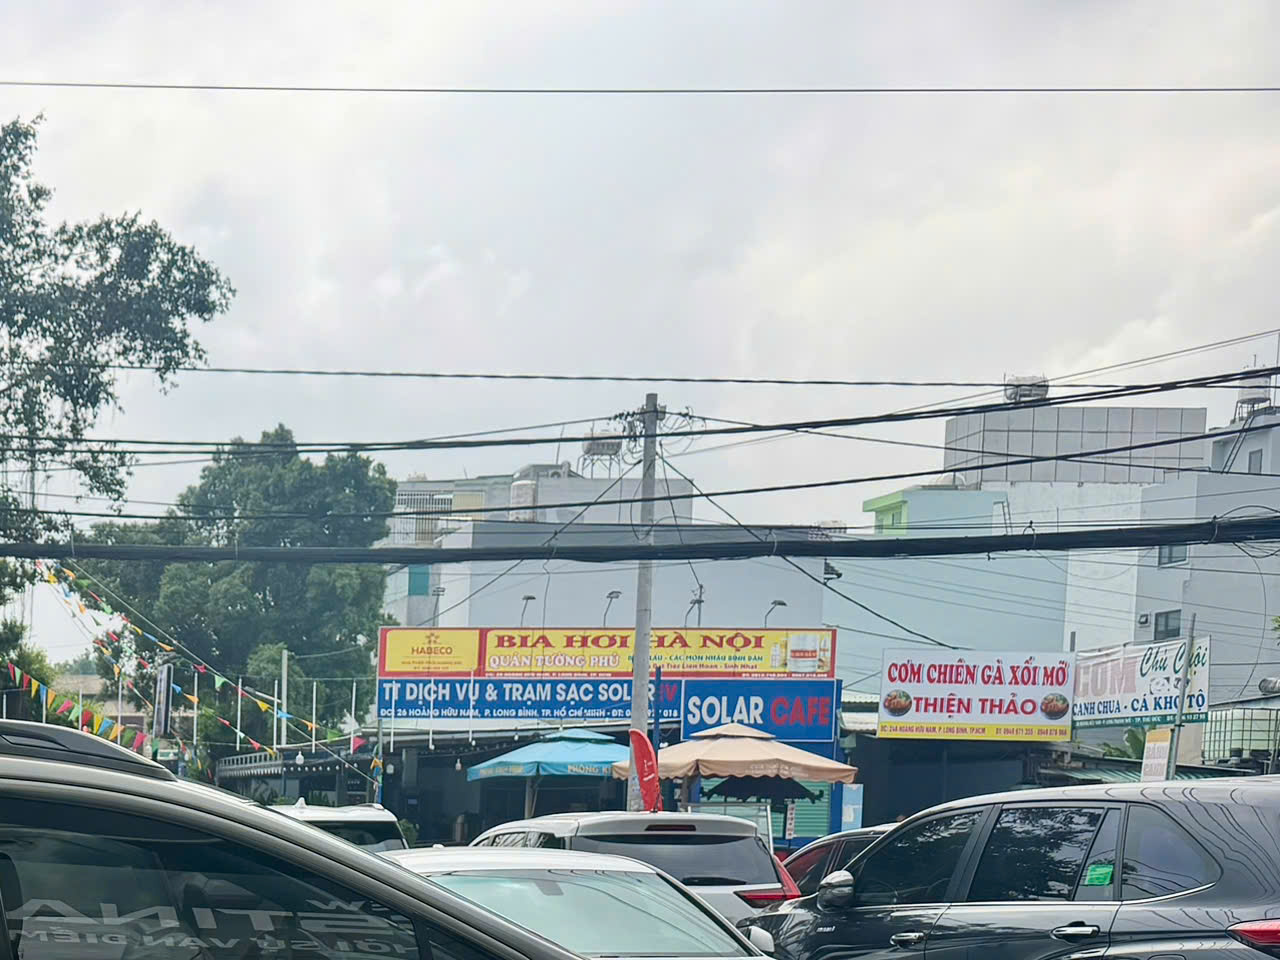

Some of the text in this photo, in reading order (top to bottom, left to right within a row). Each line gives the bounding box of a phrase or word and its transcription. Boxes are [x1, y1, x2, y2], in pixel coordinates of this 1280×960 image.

[411, 646, 454, 656] HABECO
[496, 634, 555, 649] BIA
[564, 633, 631, 649] HƠI
[700, 632, 765, 652] NỘI
[489, 652, 534, 668] QUÁN
[887, 659, 924, 684] CƠM
[981, 659, 1005, 686] GÀ
[383, 683, 401, 701] TT
[406, 683, 450, 705] DỊCH
[455, 683, 480, 705] VỤ
[485, 683, 498, 701] &
[503, 683, 551, 706] TRẠM
[556, 683, 593, 706] SẠC
[598, 683, 655, 702] SOLR
[1097, 700, 1121, 715] CHUA
[1131, 694, 1149, 712] CÁ
[493, 708, 516, 717] LONG
[687, 696, 831, 727] SOLAR CAFE
[913, 692, 1038, 719] THIỆN THẢO
